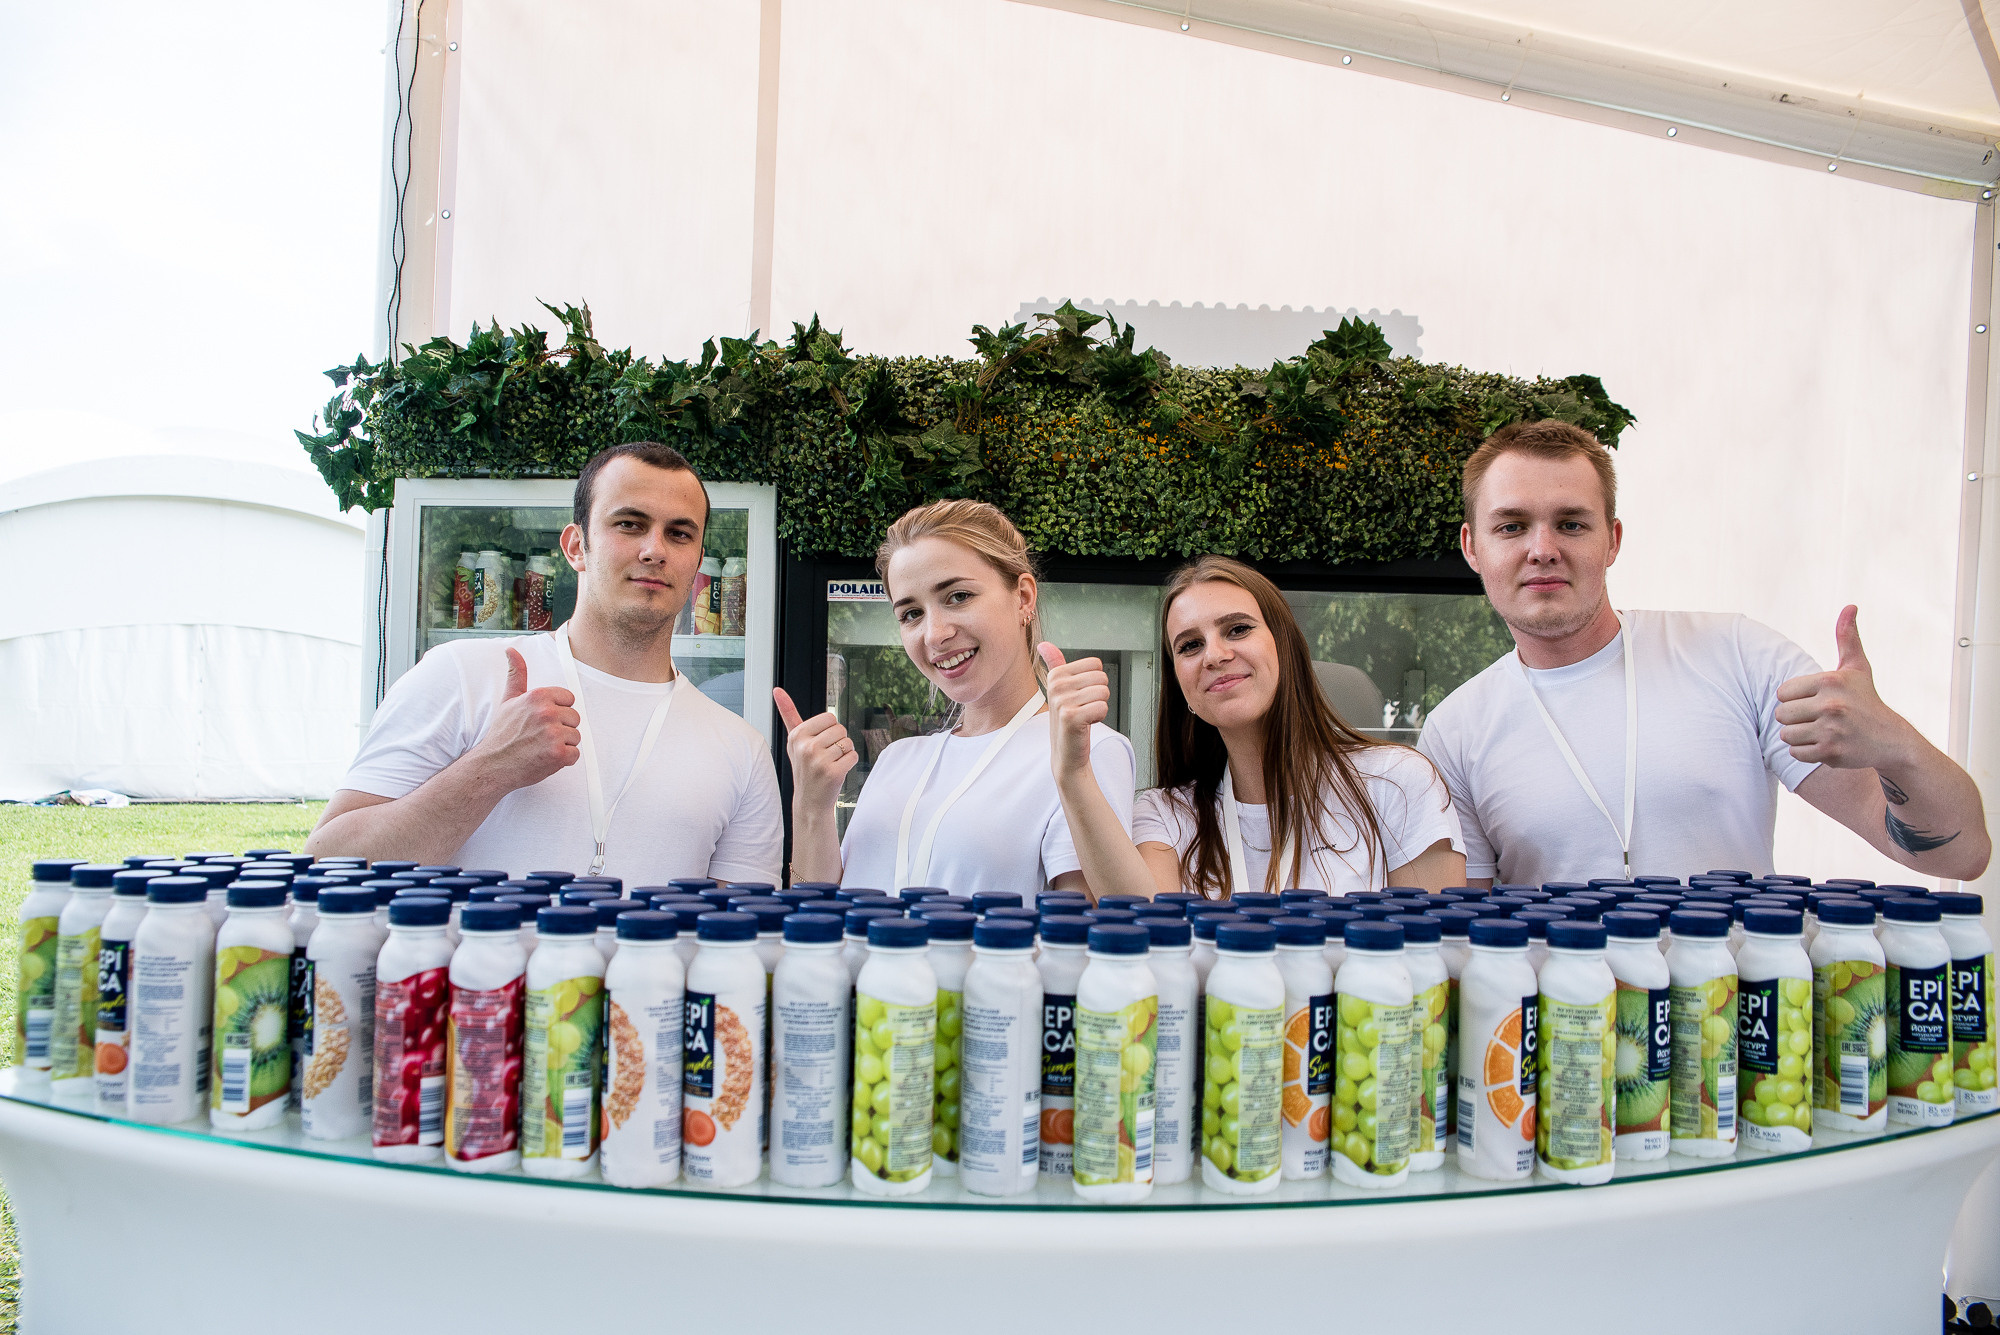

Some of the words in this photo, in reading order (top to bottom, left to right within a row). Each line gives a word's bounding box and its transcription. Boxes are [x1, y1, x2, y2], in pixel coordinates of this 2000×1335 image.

[829, 583, 886, 594] POLAIR
[1908, 979, 1943, 1001] EPI
[1656, 1000, 1670, 1024] EP
[1739, 991, 1768, 1018] EPI
[1907, 1001, 1945, 1022] CA
[1315, 1006, 1333, 1029] EP
[1739, 1016, 1770, 1041] CA
[1952, 1014, 1980, 1022] ОГУРТ
[1044, 1029, 1076, 1053] CA
[1654, 1024, 1670, 1046] C
